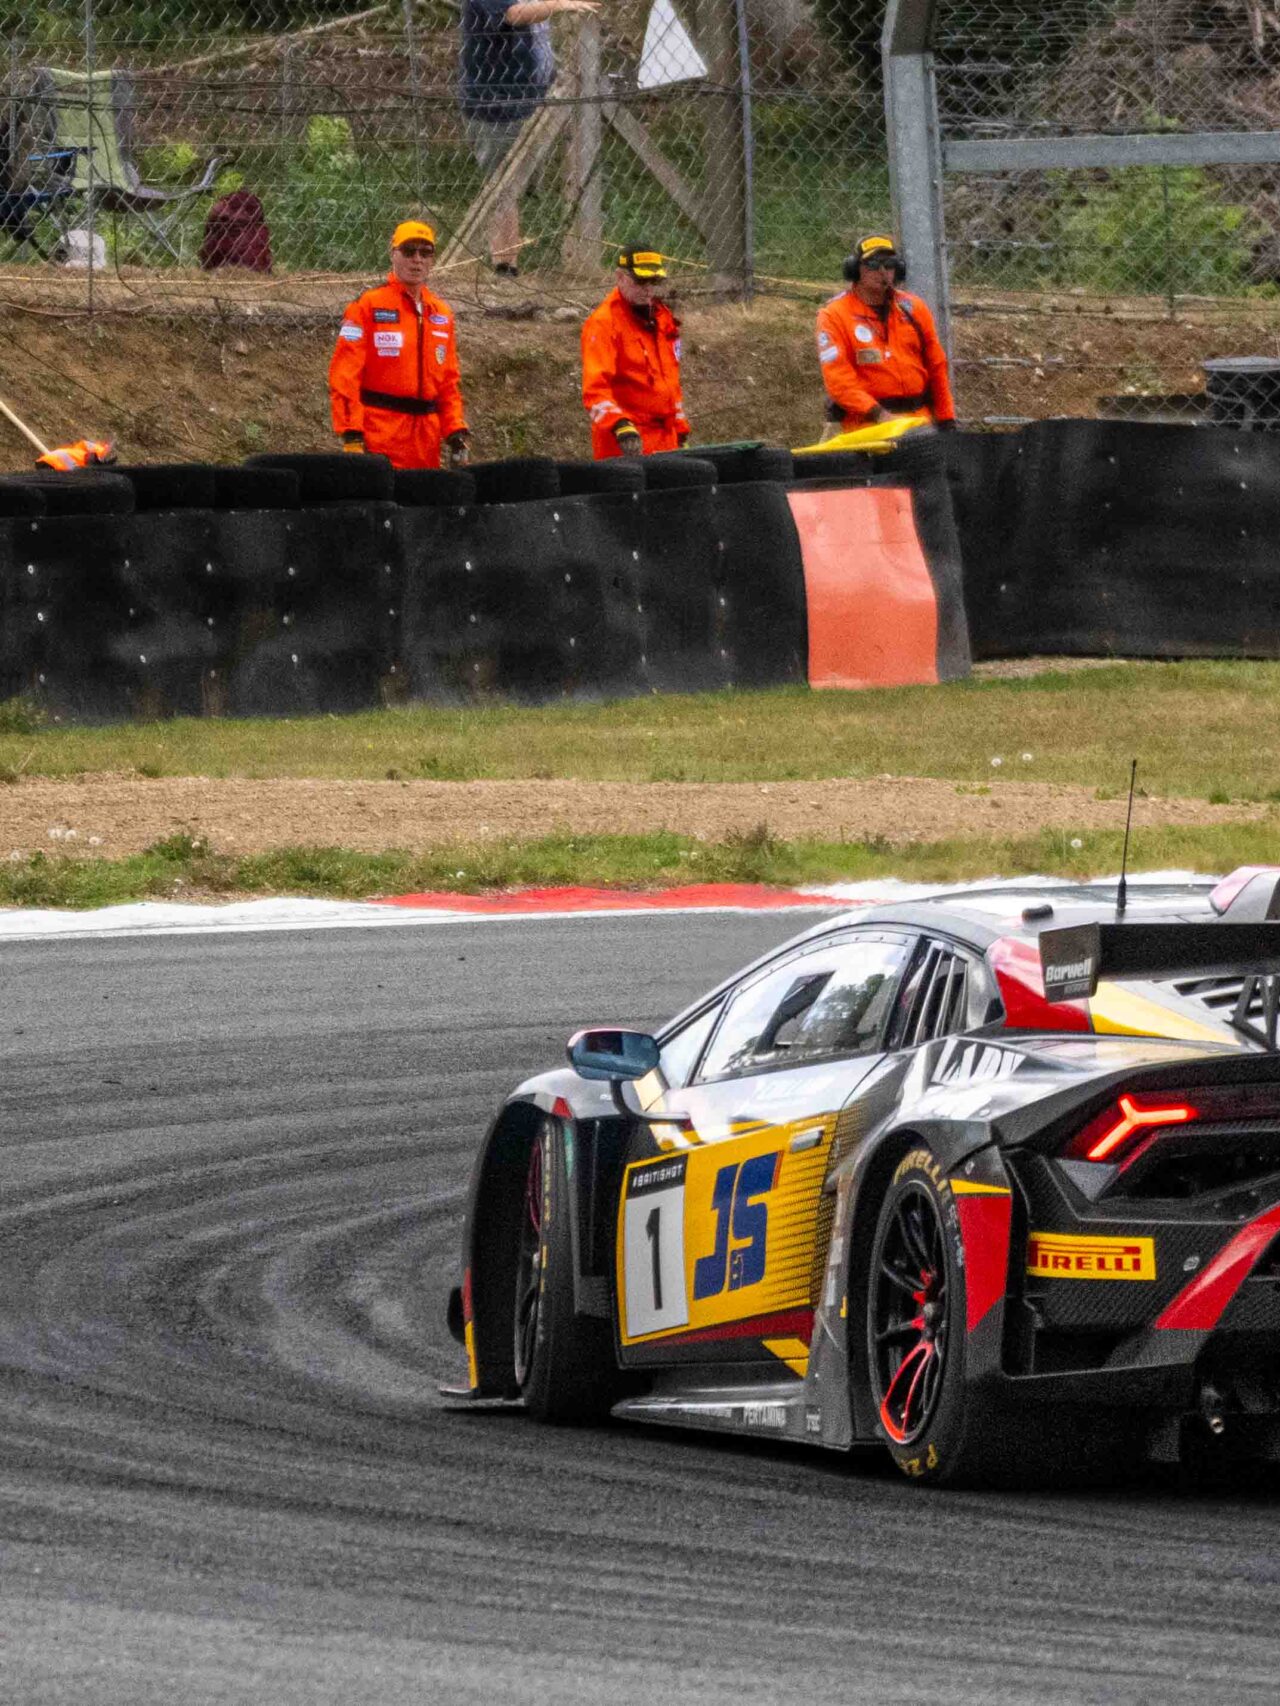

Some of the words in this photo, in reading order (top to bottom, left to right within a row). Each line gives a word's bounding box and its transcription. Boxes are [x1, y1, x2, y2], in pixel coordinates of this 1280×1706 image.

[1046, 957, 1093, 983] Barwell
[645, 1206, 663, 1311] 1
[1028, 1240, 1141, 1272] PIRELLI
